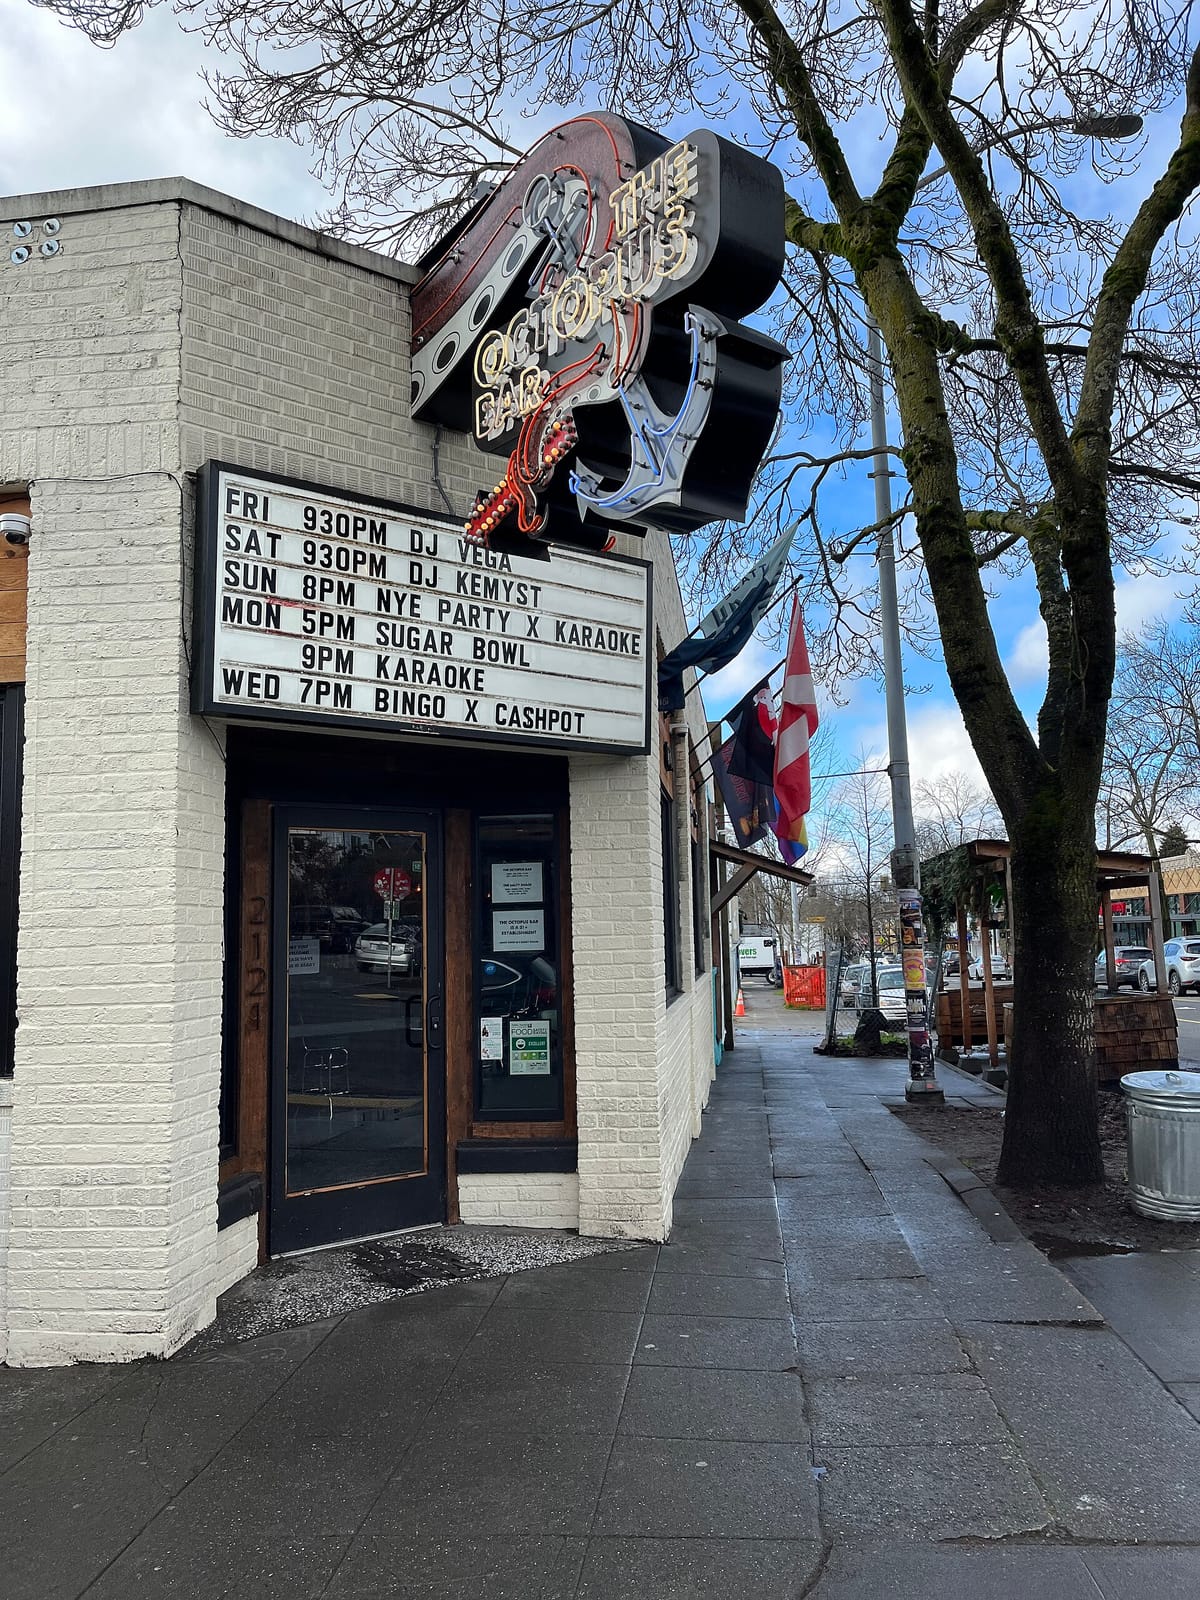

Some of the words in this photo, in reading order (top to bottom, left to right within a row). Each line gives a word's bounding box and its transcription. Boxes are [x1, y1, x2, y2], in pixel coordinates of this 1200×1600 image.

[609, 140, 697, 237] THE
[474, 204, 697, 388] OCTOPUS
[475, 365, 545, 439] BAR
[225, 524, 282, 559] SAT
[302, 539, 387, 580] 930PM
[409, 560, 438, 589] DJ
[456, 570, 542, 608] KEMYST
[226, 487, 269, 522] FRI
[303, 505, 387, 546] 930PM
[410, 528, 438, 557] DJ
[457, 539, 512, 572] VEGA
[222, 595, 282, 630] MON
[302, 608, 355, 641] 5PM
[376, 621, 453, 656] SUGAR
[472, 636, 530, 668] BOWL
[224, 559, 277, 594] SUN
[302, 574, 355, 607] 8PM
[376, 587, 421, 619] NYE
[438, 598, 511, 633] PARTY
[526, 614, 540, 639] X
[555, 619, 641, 656] KARAOKE
[222, 667, 280, 700] WED
[299, 677, 353, 709] 7PM
[374, 687, 446, 719] BINGO
[464, 698, 479, 723] X
[495, 702, 585, 734] CASHPOT
[301, 643, 354, 675] 9PM
[376, 654, 485, 692] KARAOKE
